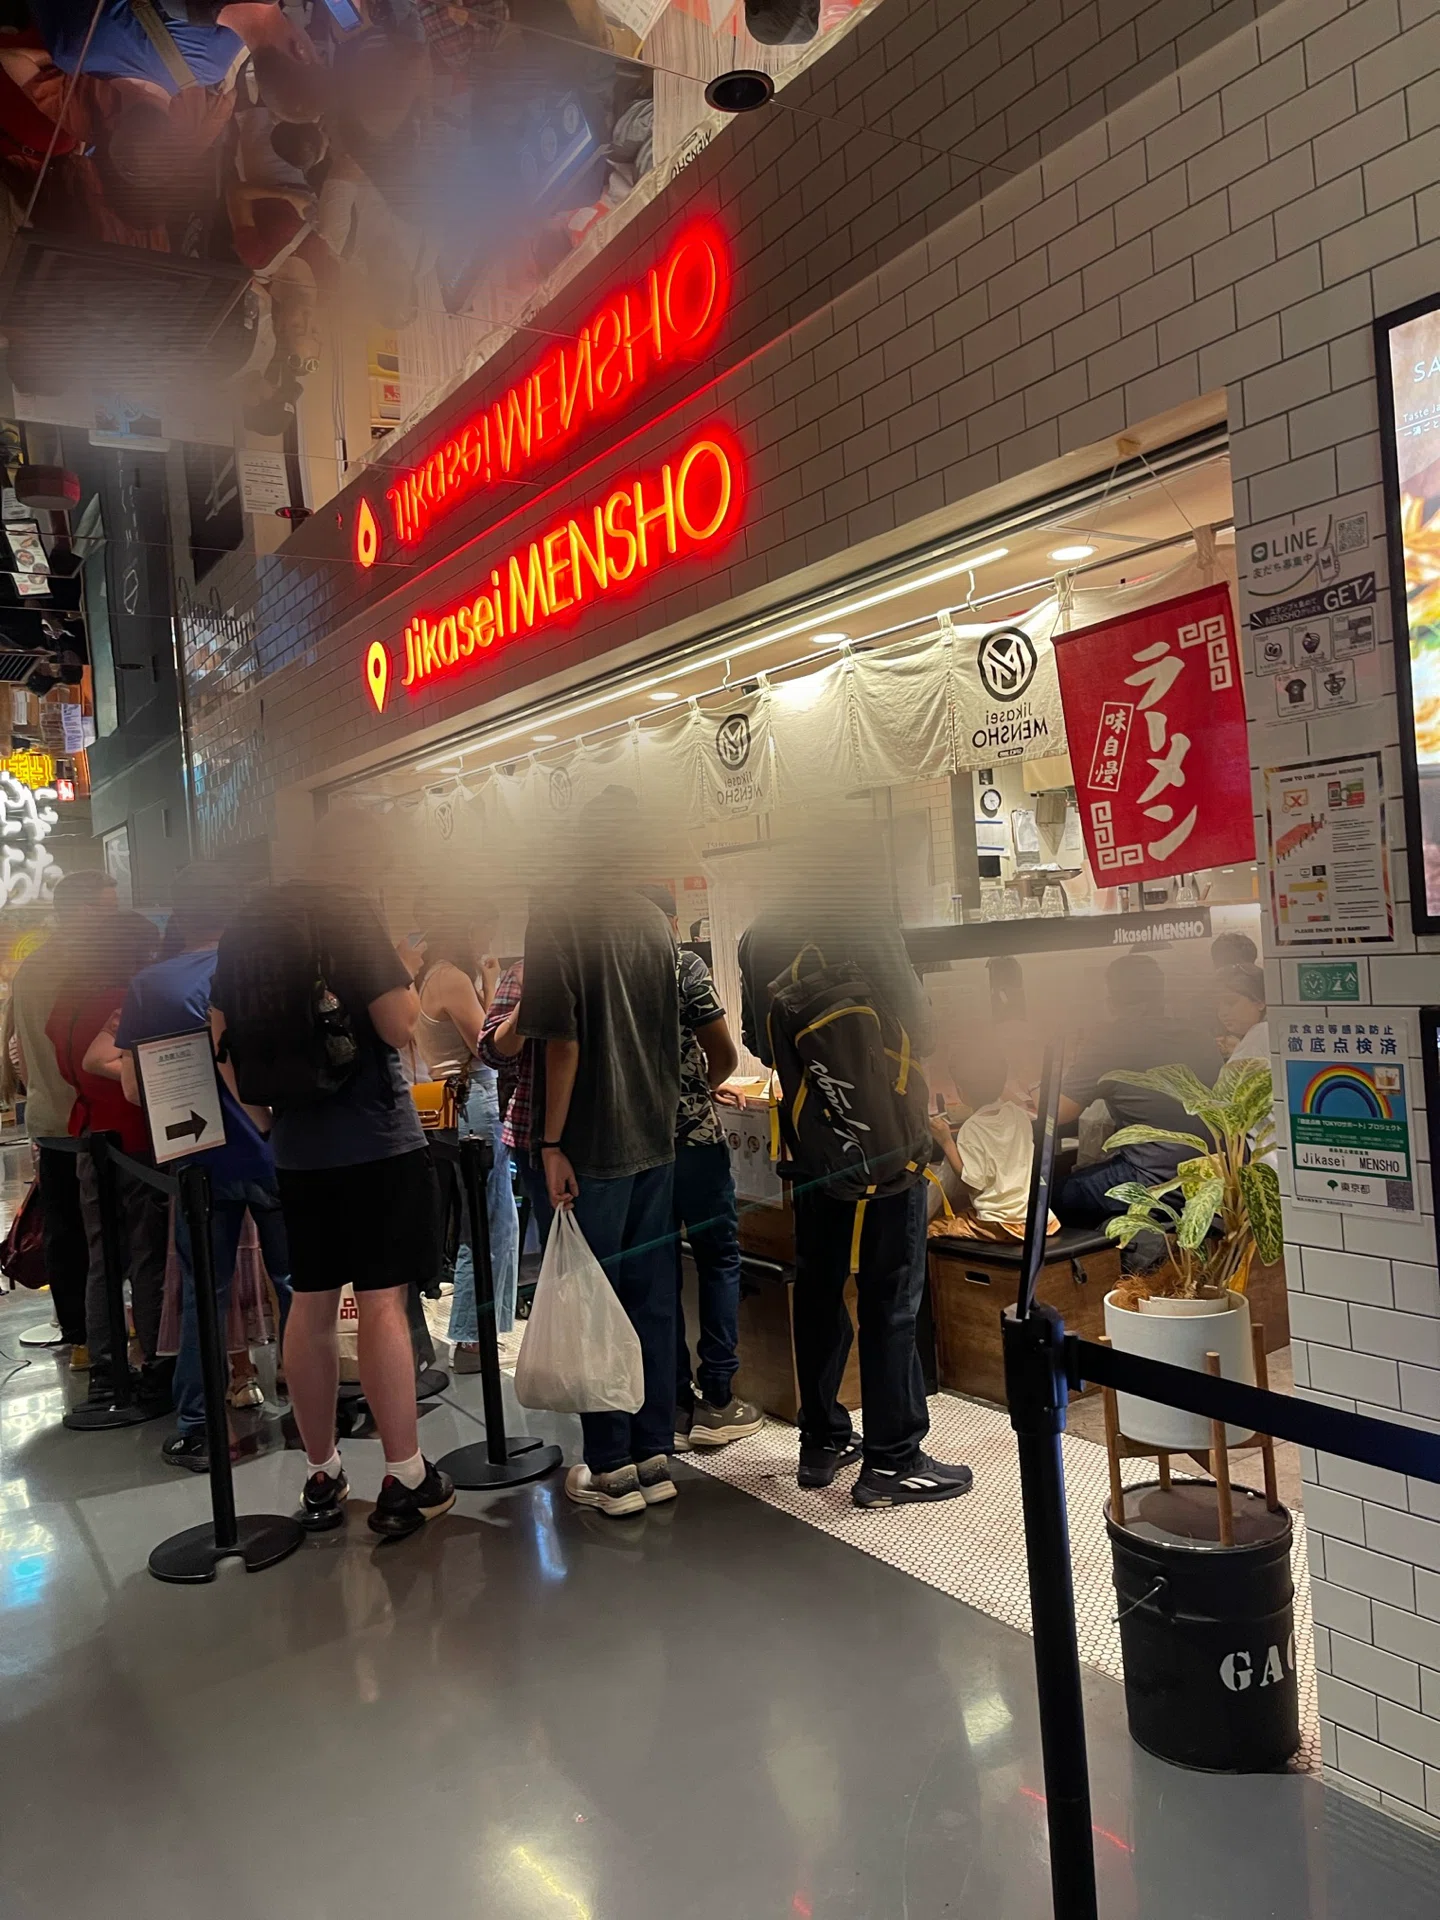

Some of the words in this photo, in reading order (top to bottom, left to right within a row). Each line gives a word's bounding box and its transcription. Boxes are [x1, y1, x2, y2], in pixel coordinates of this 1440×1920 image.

[1403, 409, 1429, 422] Taste
[1272, 527, 1319, 557] LINE
[402, 570, 503, 686] Jikasei
[509, 440, 731, 633] MENSHO
[1252, 553, 1313, 579] 友だち募集中
[1095, 708, 1127, 786] 味自慢
[1124, 641, 1197, 861] ラーメン
[1112, 927, 1151, 944] Jikasei
[1151, 920, 1205, 941] MENSHO
[1289, 1023, 1394, 1036] 飲食店等感染防止
[1287, 1036, 1398, 1055] 徹底点検済
[1302, 1152, 1346, 1168] Jikasei
[1359, 1156, 1400, 1173] MENSHO
[1340, 1181, 1371, 1194] 東京都
[1219, 1630, 1295, 1692] GA
